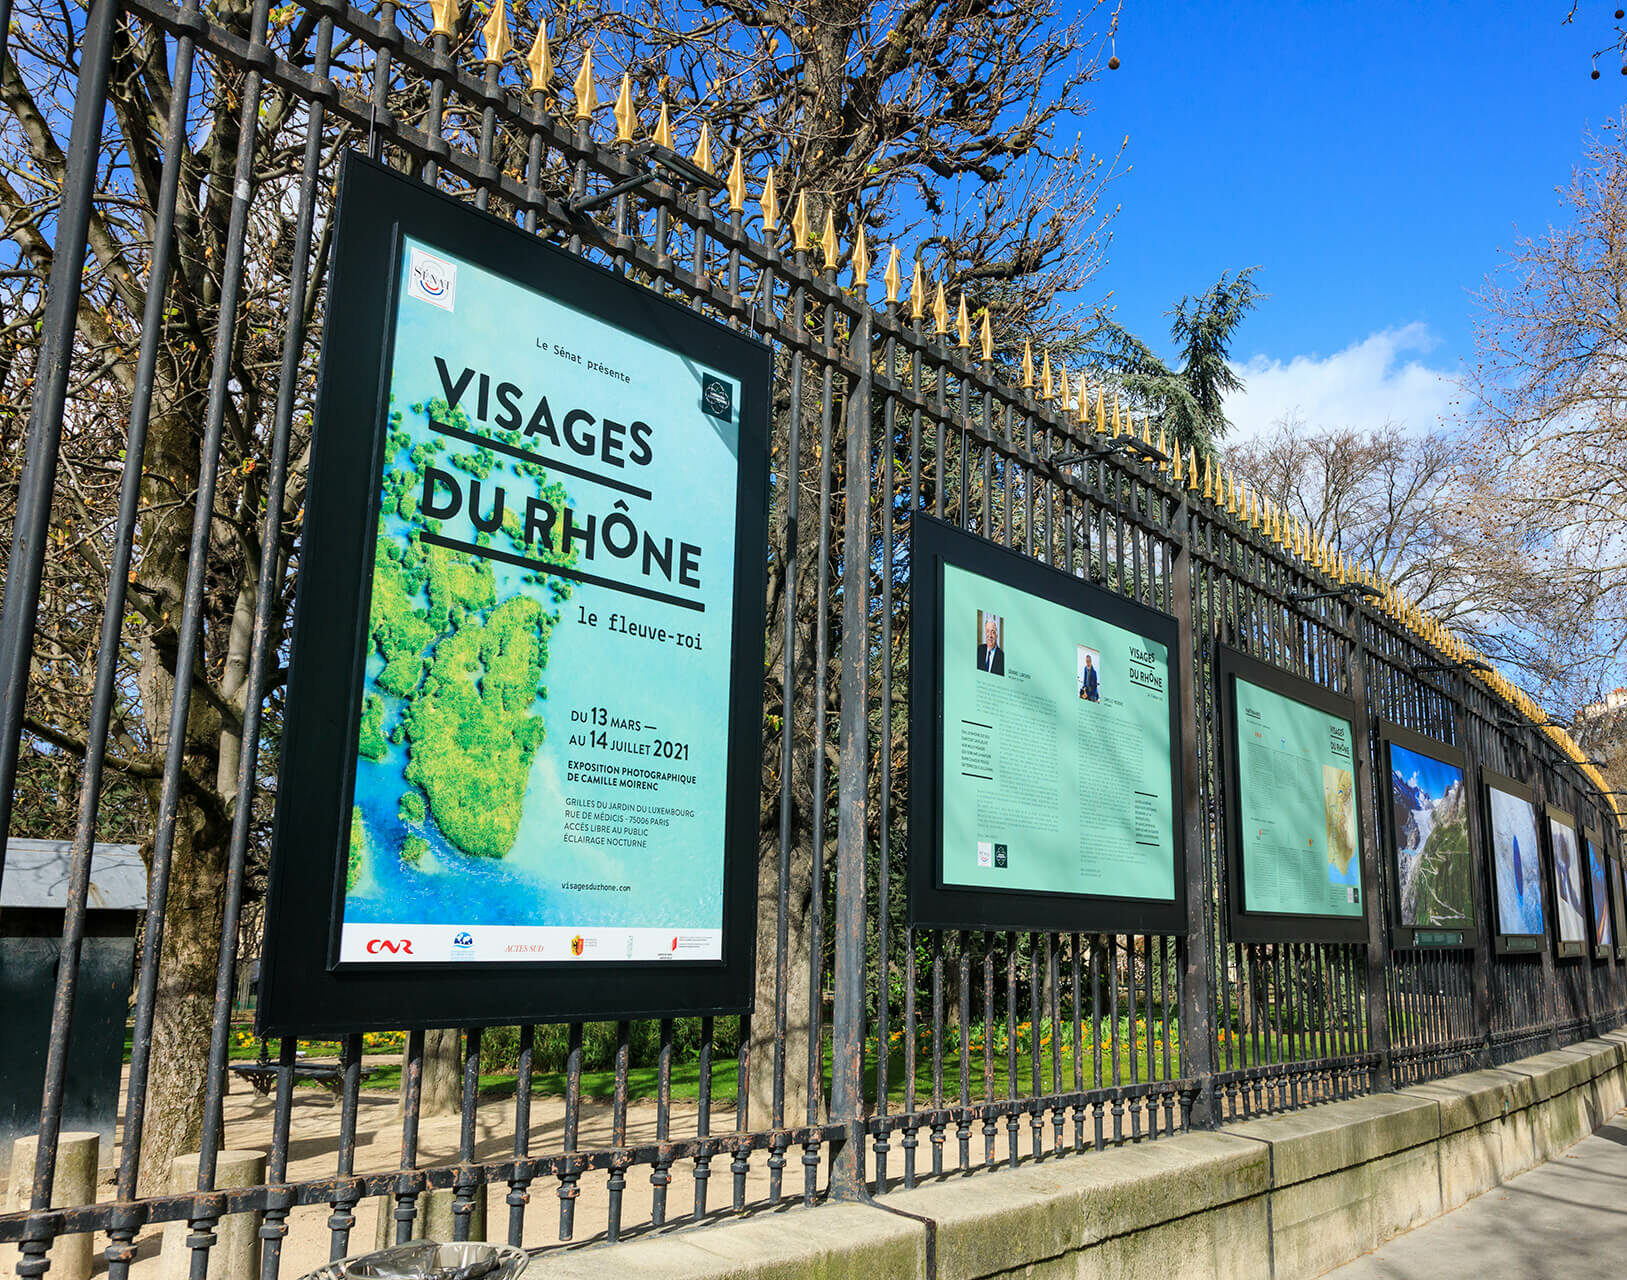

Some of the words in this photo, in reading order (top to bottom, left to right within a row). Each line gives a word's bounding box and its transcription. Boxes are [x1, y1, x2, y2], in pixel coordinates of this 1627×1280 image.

[535, 337, 549, 352] Le
[553, 345, 582, 365] Sénat
[587, 360, 631, 384] présente
[434, 356, 653, 468] VISAGES
[421, 465, 506, 534] DU
[524, 499, 702, 589] RHÔNE
[577, 606, 598, 627] le
[608, 613, 703, 651] fleuve-roi
[1129, 646, 1156, 664] VISAGES
[1129, 668, 1139, 680] DU
[1140, 669, 1163, 688] RHÔNE
[571, 710, 588, 723] DU
[591, 706, 608, 726] 13
[610, 717, 641, 731] MARS
[569, 734, 586, 747] AU
[590, 730, 608, 749] 14
[610, 740, 651, 756] JUILLET
[653, 739, 689, 761] 2021
[567, 772, 579, 782] DE
[580, 774, 618, 787] CAMILLE
[618, 779, 659, 791] MOIRENC
[568, 760, 620, 775] EXPOSITION
[621, 767, 697, 785] PHOTOGRAPHIQUE
[564, 809, 581, 819] RUE
[581, 811, 592, 820] DE
[594, 811, 624, 822] MÉDICIS
[629, 815, 650, 826] 75006
[650, 817, 670, 827] PARIS
[565, 797, 596, 808] GRILLES
[596, 800, 608, 810] DU
[608, 802, 635, 812] JARDIN
[636, 804, 648, 814] DU
[648, 806, 695, 818] LUXEMBOURG
[564, 822, 589, 832] ACCÈS
[590, 823, 611, 834] LIBRE
[612, 826, 623, 835] AU
[623, 827, 649, 837] PUBLIC
[563, 834, 605, 846] ÉCLAIRAGE
[606, 838, 647, 849] NOCTURNE
[561, 881, 632, 892] visagesdurhone.com
